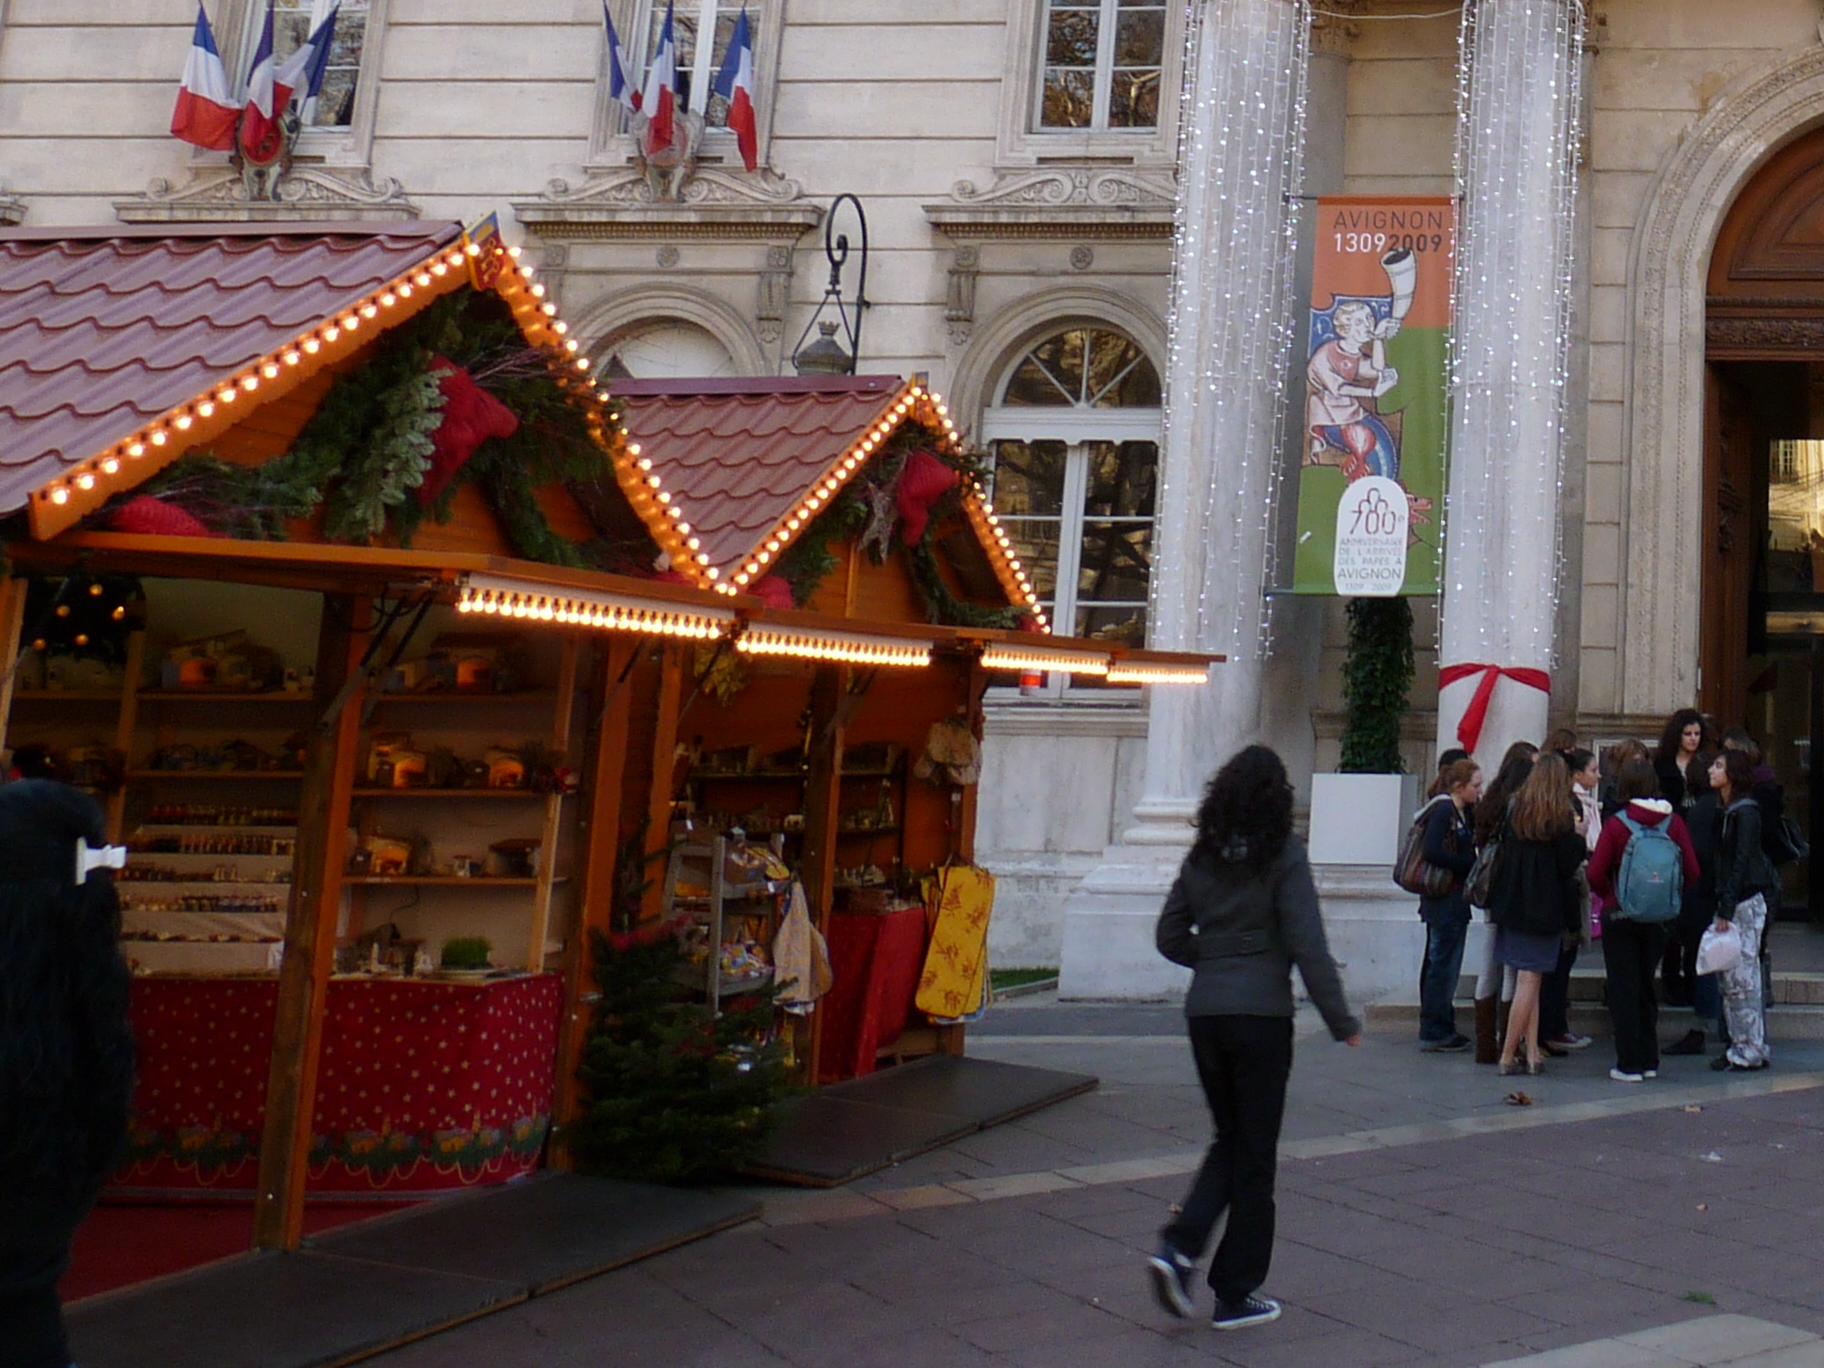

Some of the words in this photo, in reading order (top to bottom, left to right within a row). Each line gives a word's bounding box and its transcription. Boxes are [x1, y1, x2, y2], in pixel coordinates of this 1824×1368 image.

[1333, 210, 1443, 230] AVIGNON
[1338, 557, 1355, 566] DES
[1362, 557, 1390, 566] PAPES
[1337, 567, 1401, 580] AVIGNON
